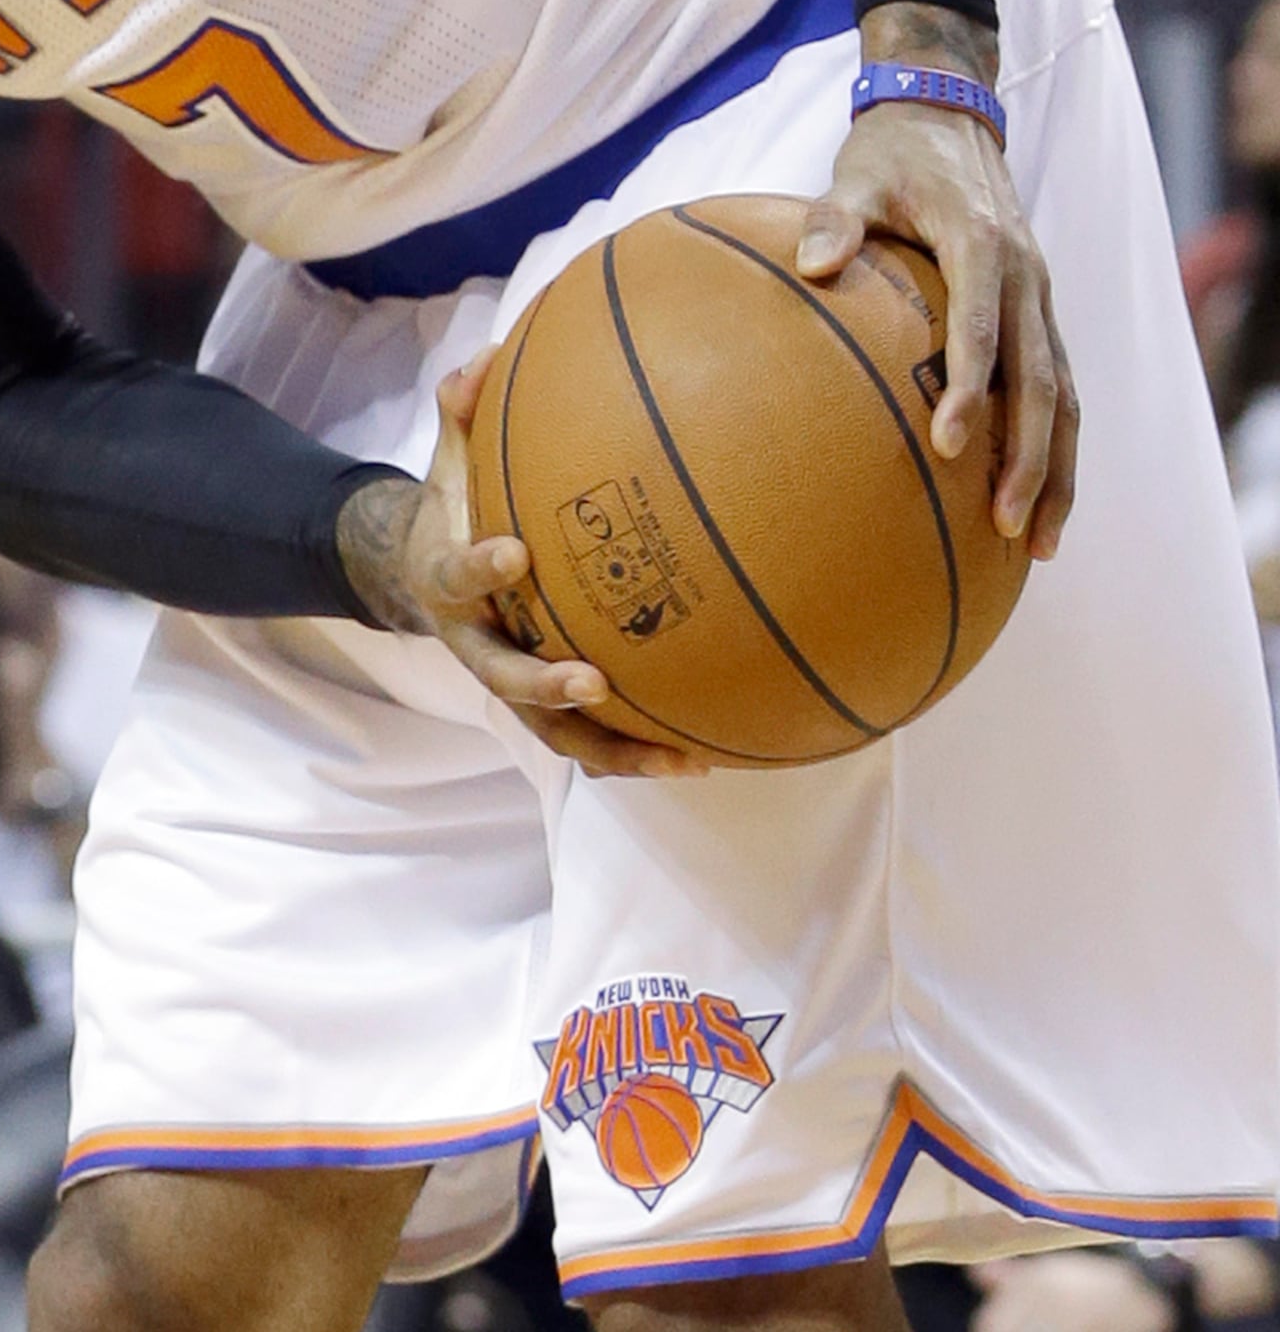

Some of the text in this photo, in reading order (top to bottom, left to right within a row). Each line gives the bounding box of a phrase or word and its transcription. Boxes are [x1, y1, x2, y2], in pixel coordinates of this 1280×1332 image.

[90, 17, 402, 166] 7
[541, 992, 775, 1111] KNICKS
[595, 976, 691, 1008] NEW YORK
